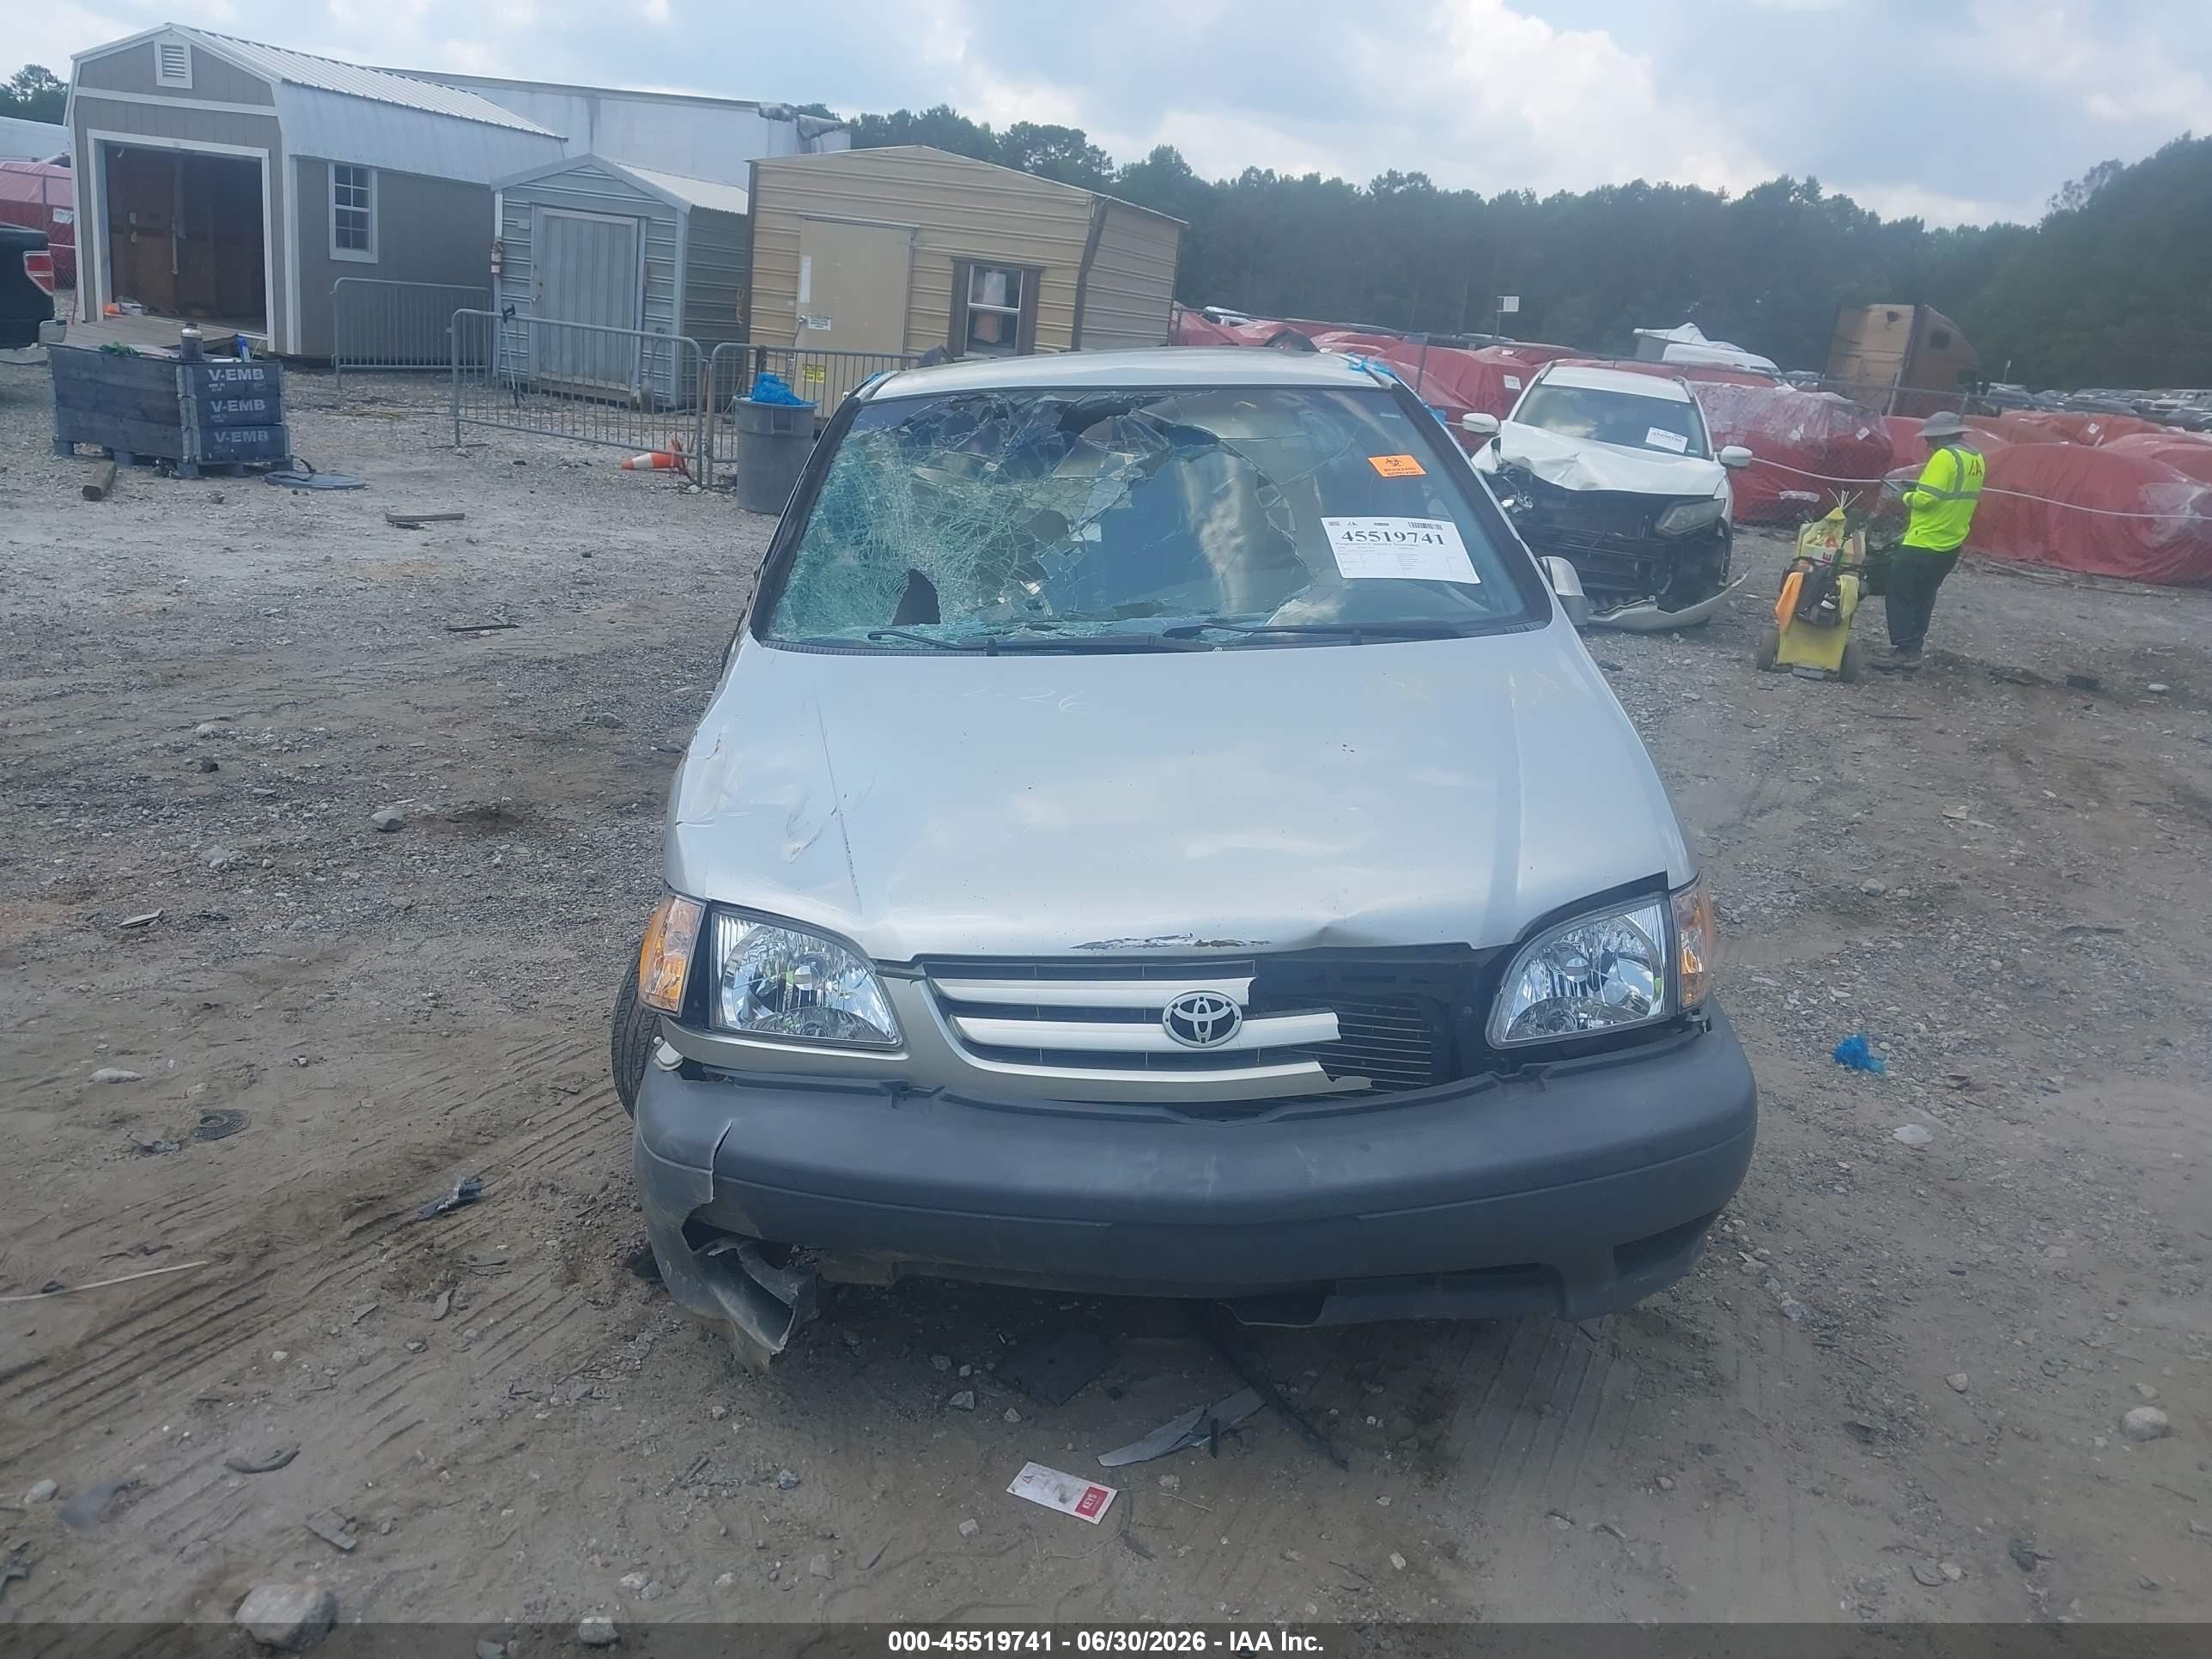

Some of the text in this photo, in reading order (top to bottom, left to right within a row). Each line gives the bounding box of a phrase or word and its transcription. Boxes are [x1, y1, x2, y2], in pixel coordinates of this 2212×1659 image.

[207, 368, 264, 381] V-EMB
[210, 399, 266, 412] V-EMB
[214, 430, 269, 443] V-EMB
[1341, 531, 1445, 545] 45519741
